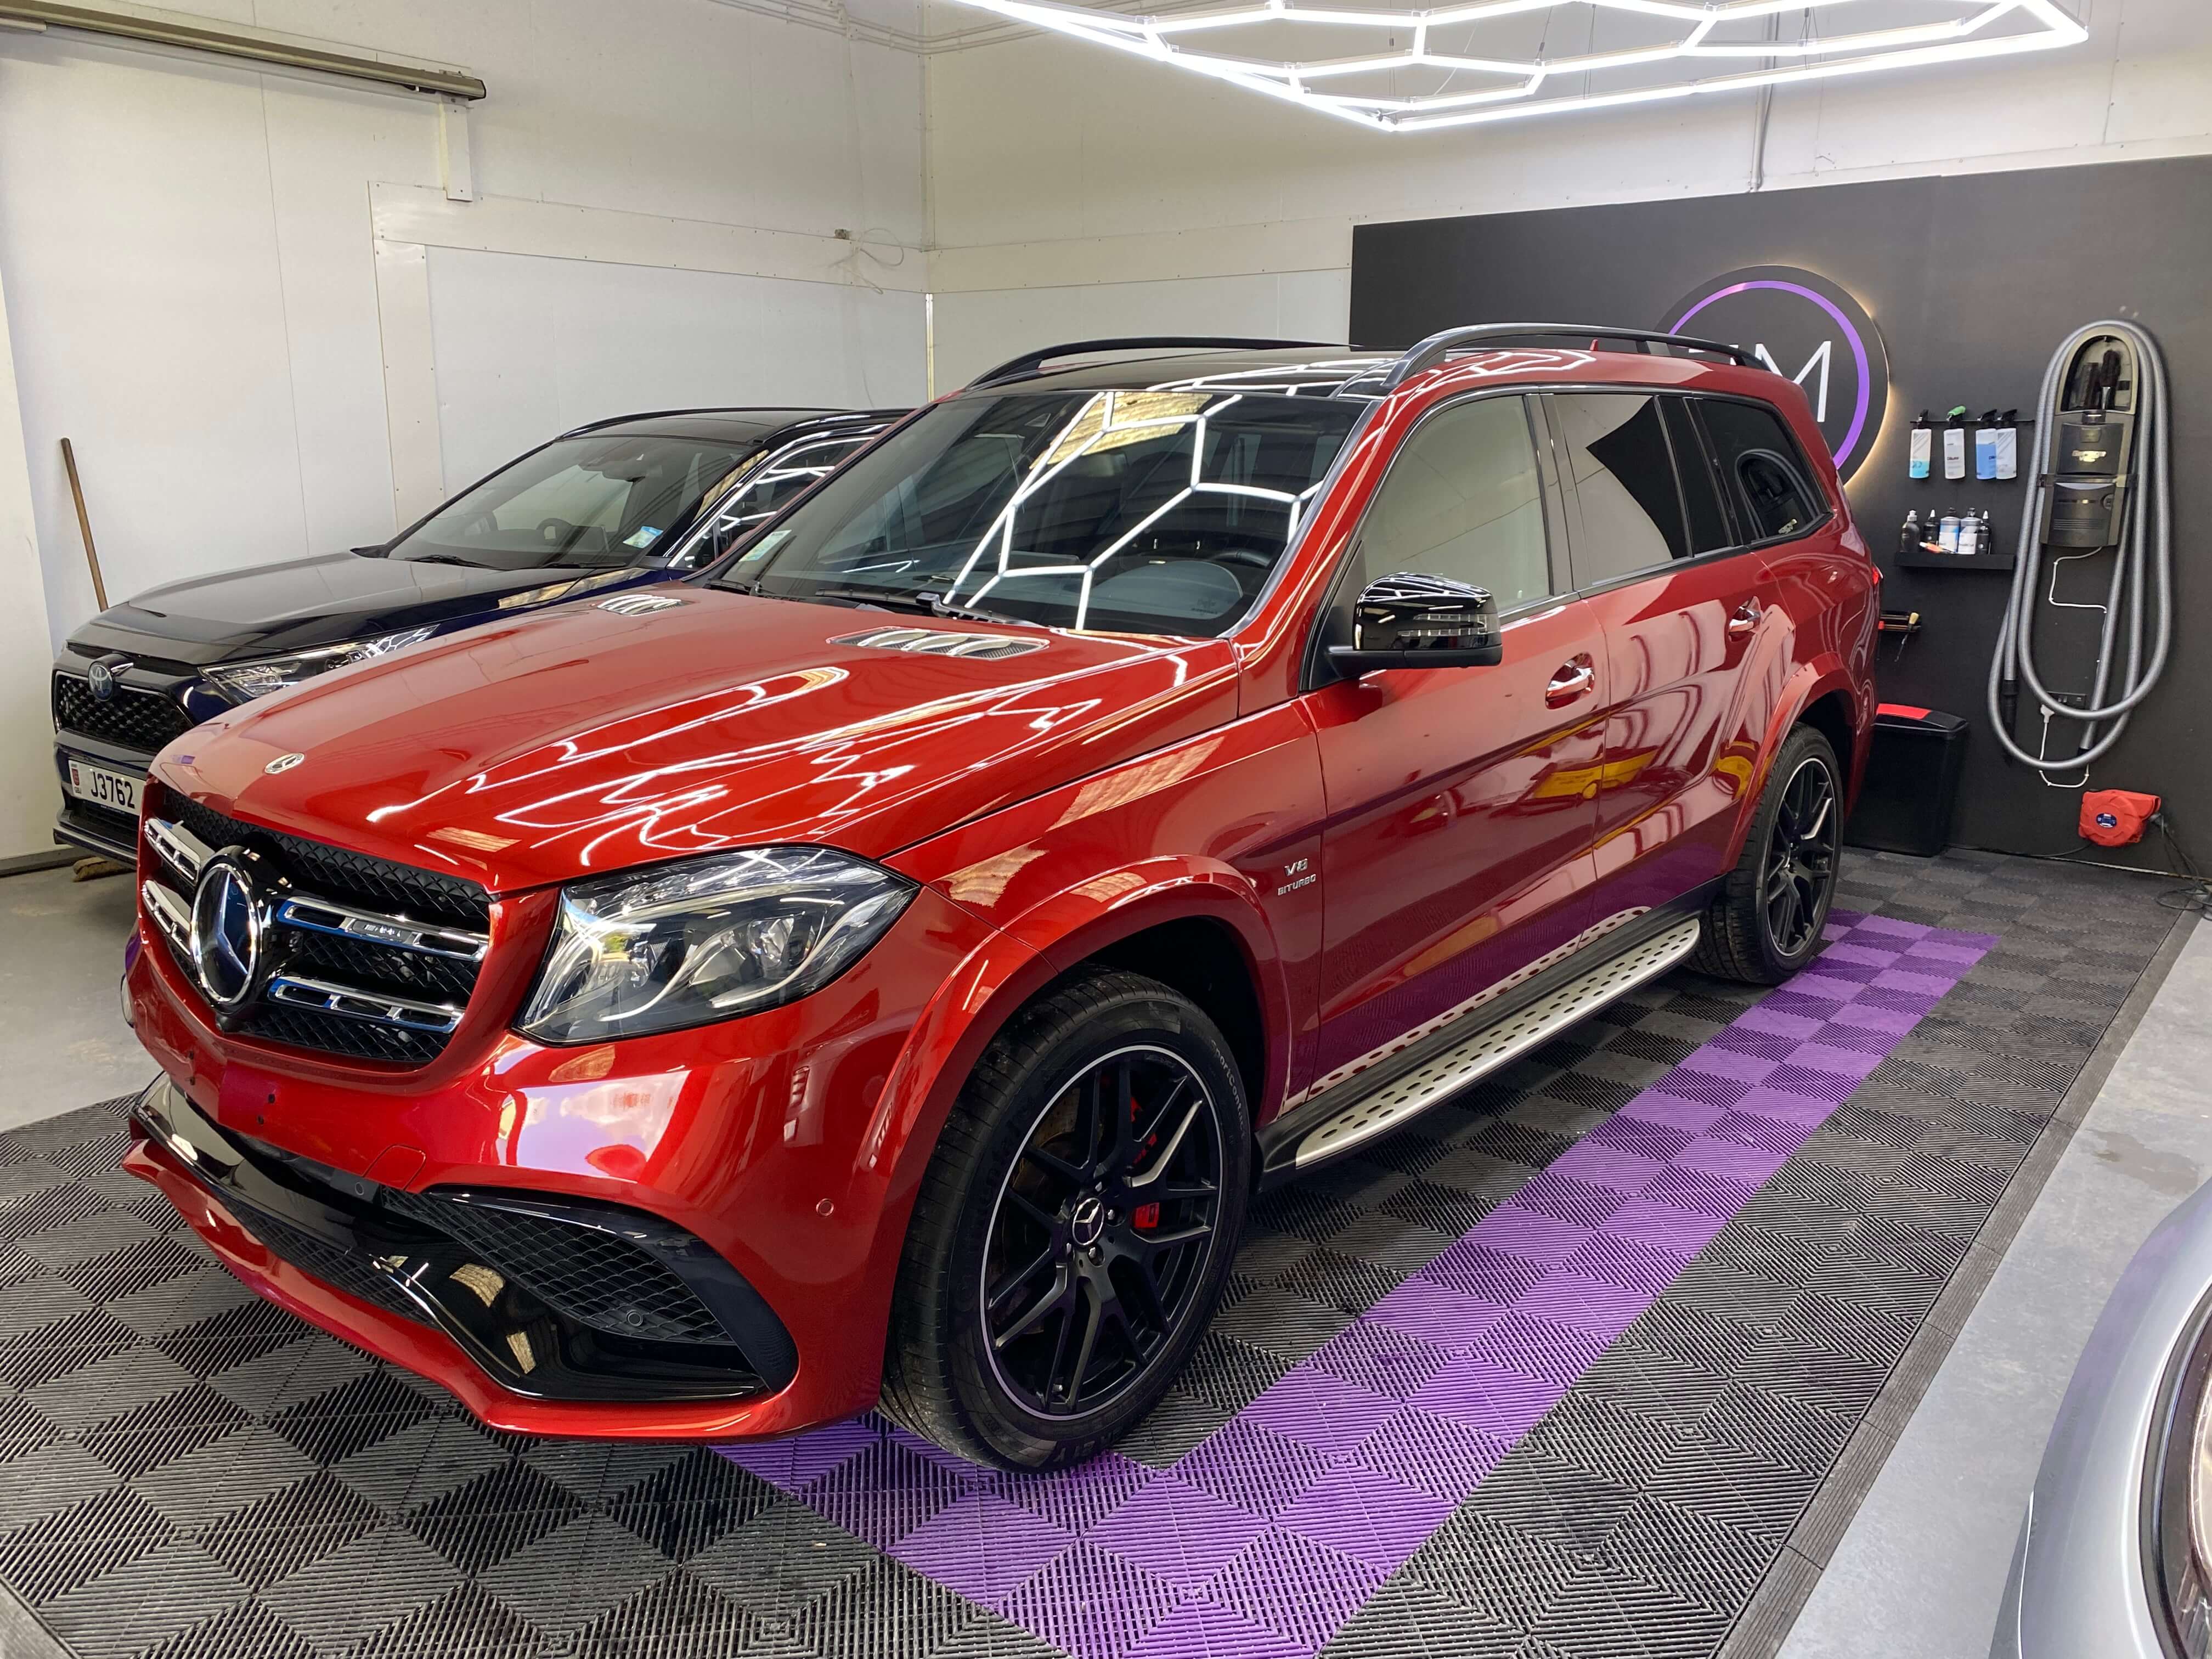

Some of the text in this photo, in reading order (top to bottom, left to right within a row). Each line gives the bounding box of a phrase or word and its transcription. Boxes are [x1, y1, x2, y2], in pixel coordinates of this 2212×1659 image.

[91, 771, 135, 809] J3762
[1284, 859, 1308, 876] V8
[1278, 874, 1316, 896] BITURBO
